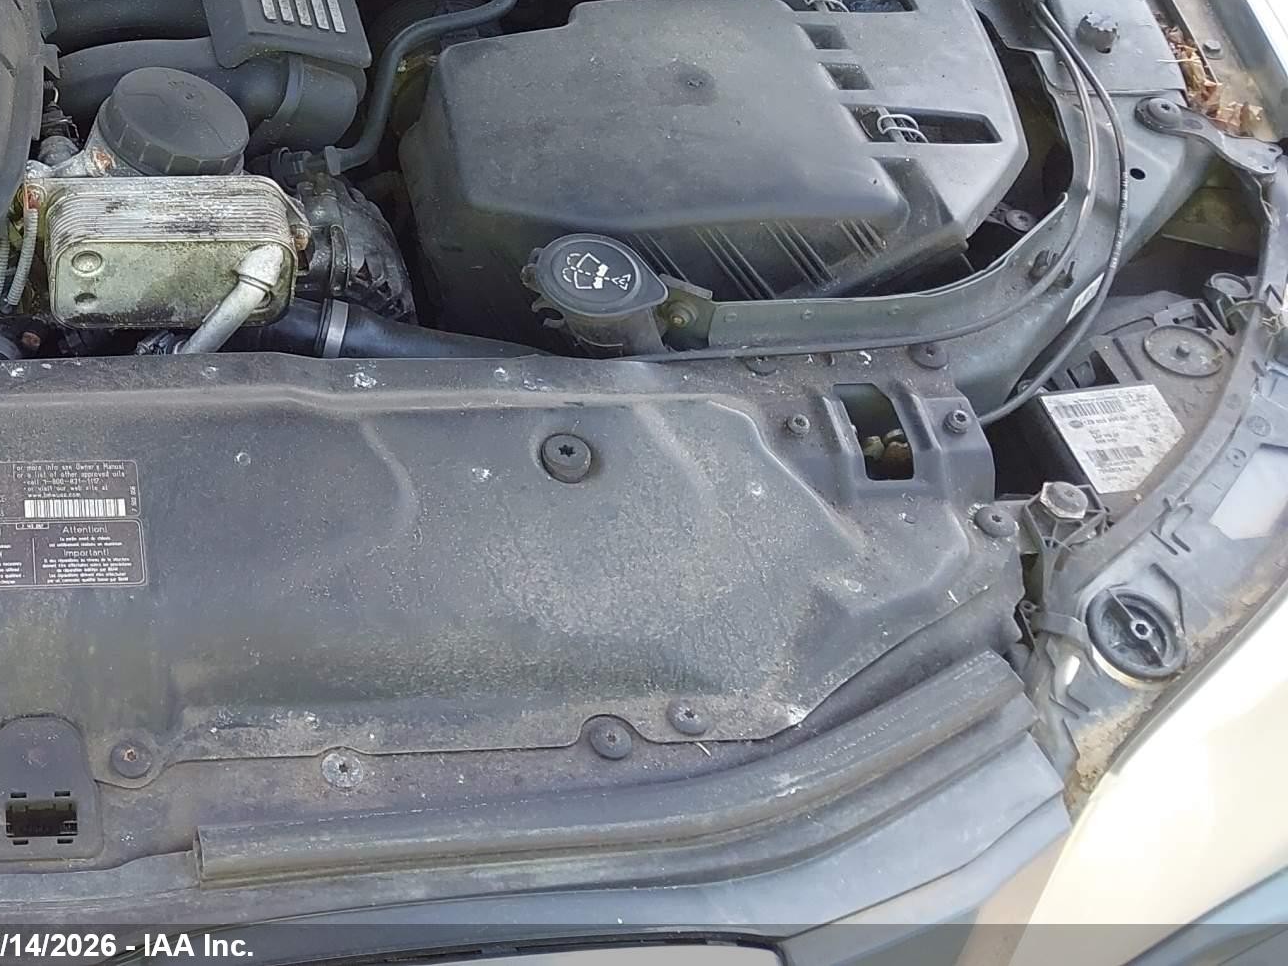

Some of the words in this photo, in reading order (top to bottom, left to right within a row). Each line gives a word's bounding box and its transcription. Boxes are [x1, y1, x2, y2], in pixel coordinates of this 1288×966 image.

[103, 462, 125, 470] Manual
[61, 470, 77, 478] other
[81, 470, 109, 478] approved
[62, 525, 108, 534] Attention!
[64, 548, 109, 557] Important!
